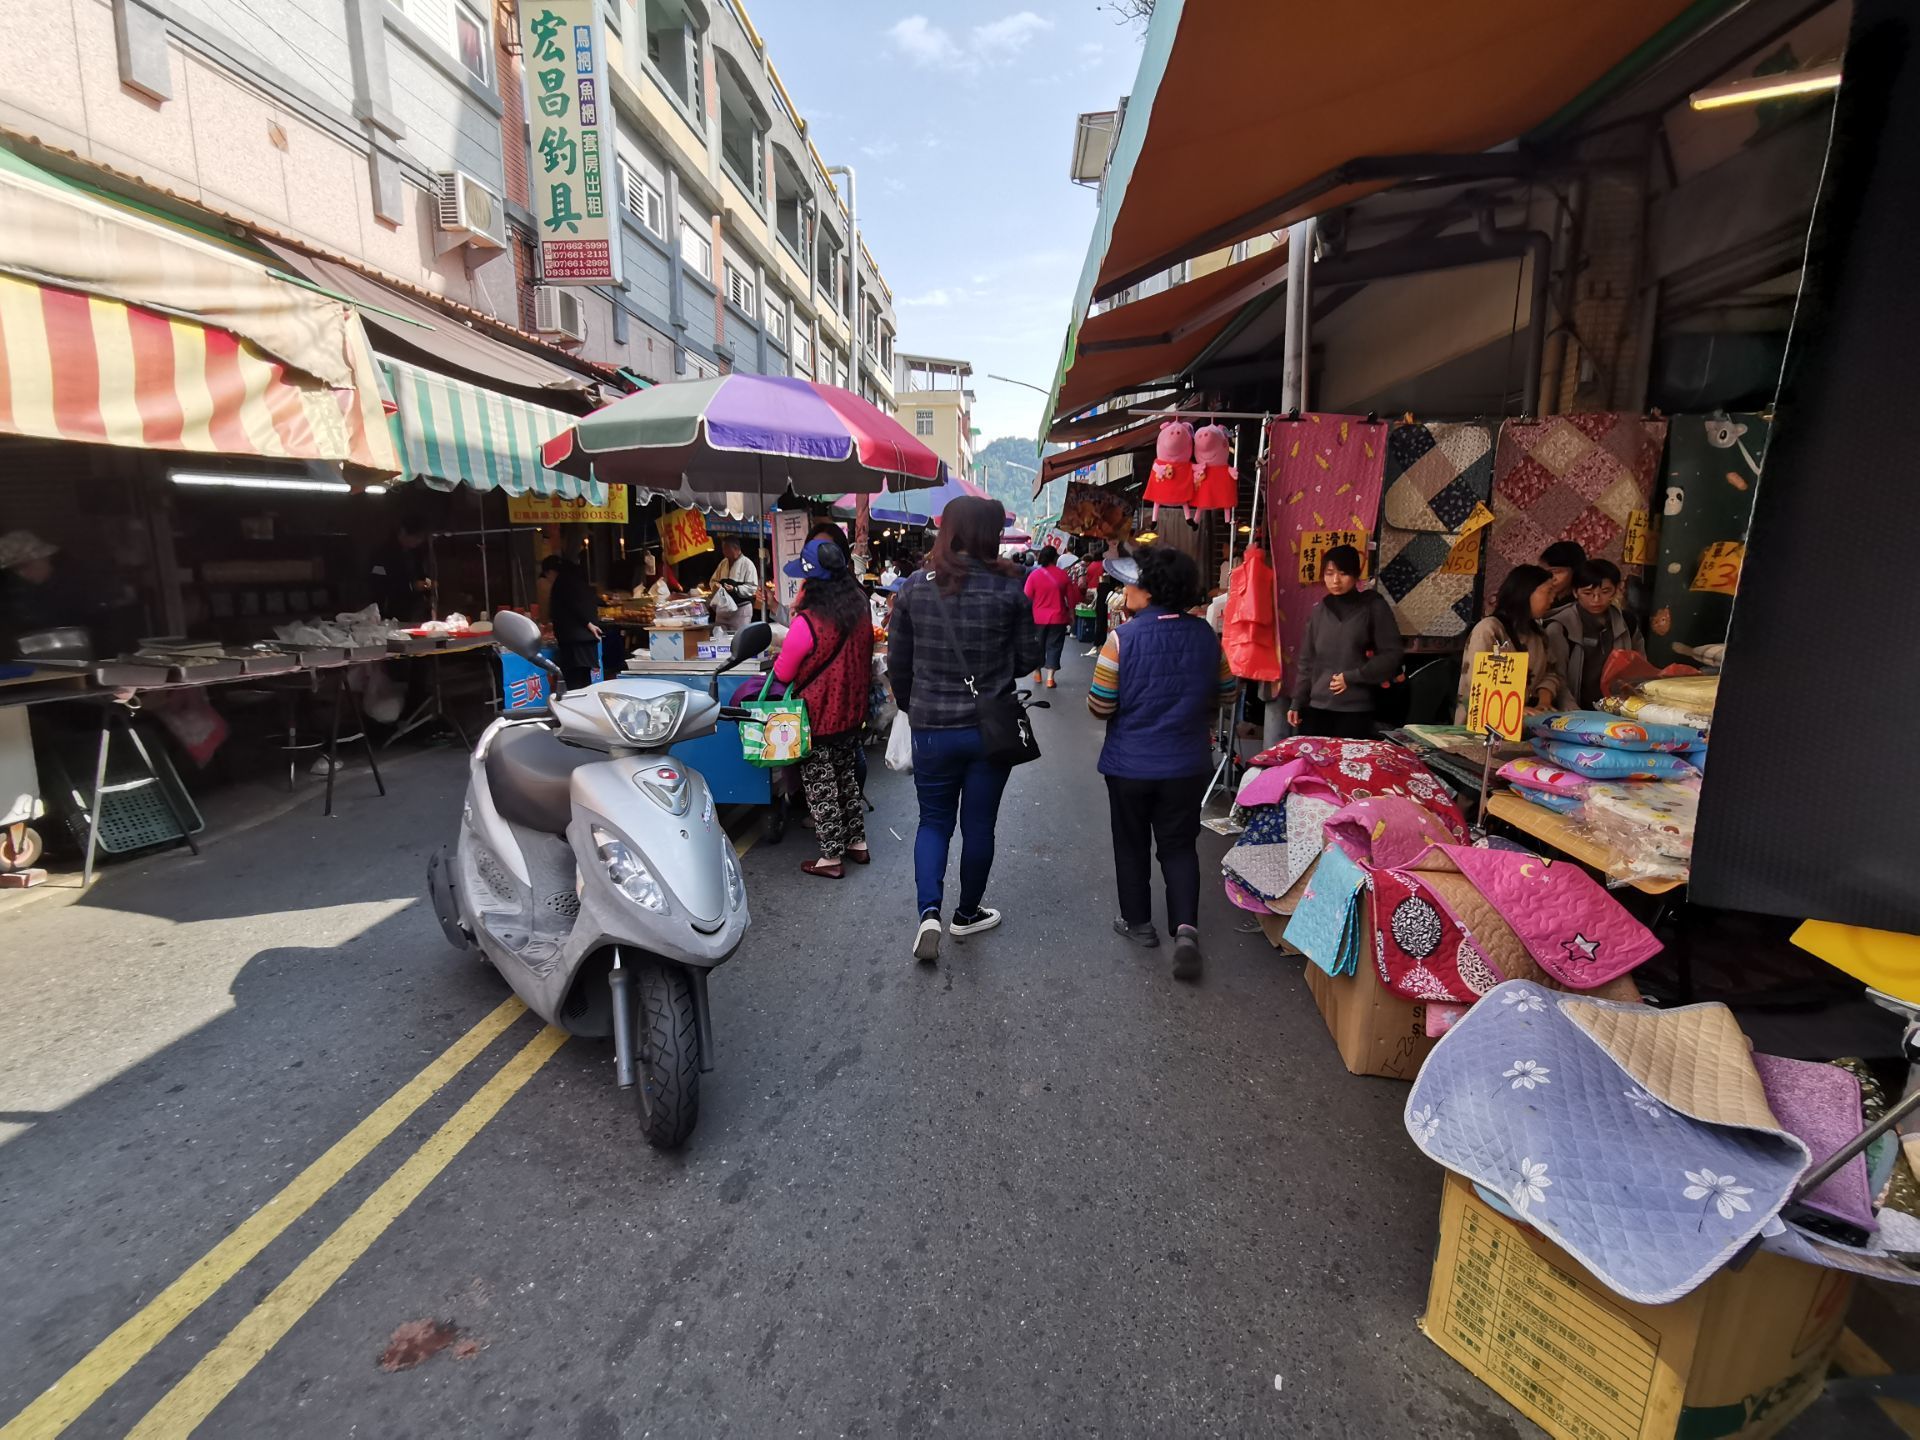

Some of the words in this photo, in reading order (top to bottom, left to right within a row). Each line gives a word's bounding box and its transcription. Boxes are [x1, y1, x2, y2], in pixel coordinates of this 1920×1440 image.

[531, 9, 583, 234] 宏昌釣具
[579, 81, 596, 124] 魚網
[582, 133, 603, 214] 套房出租
[1301, 548, 1317, 581] 特價
[1481, 687, 1522, 736] 100
